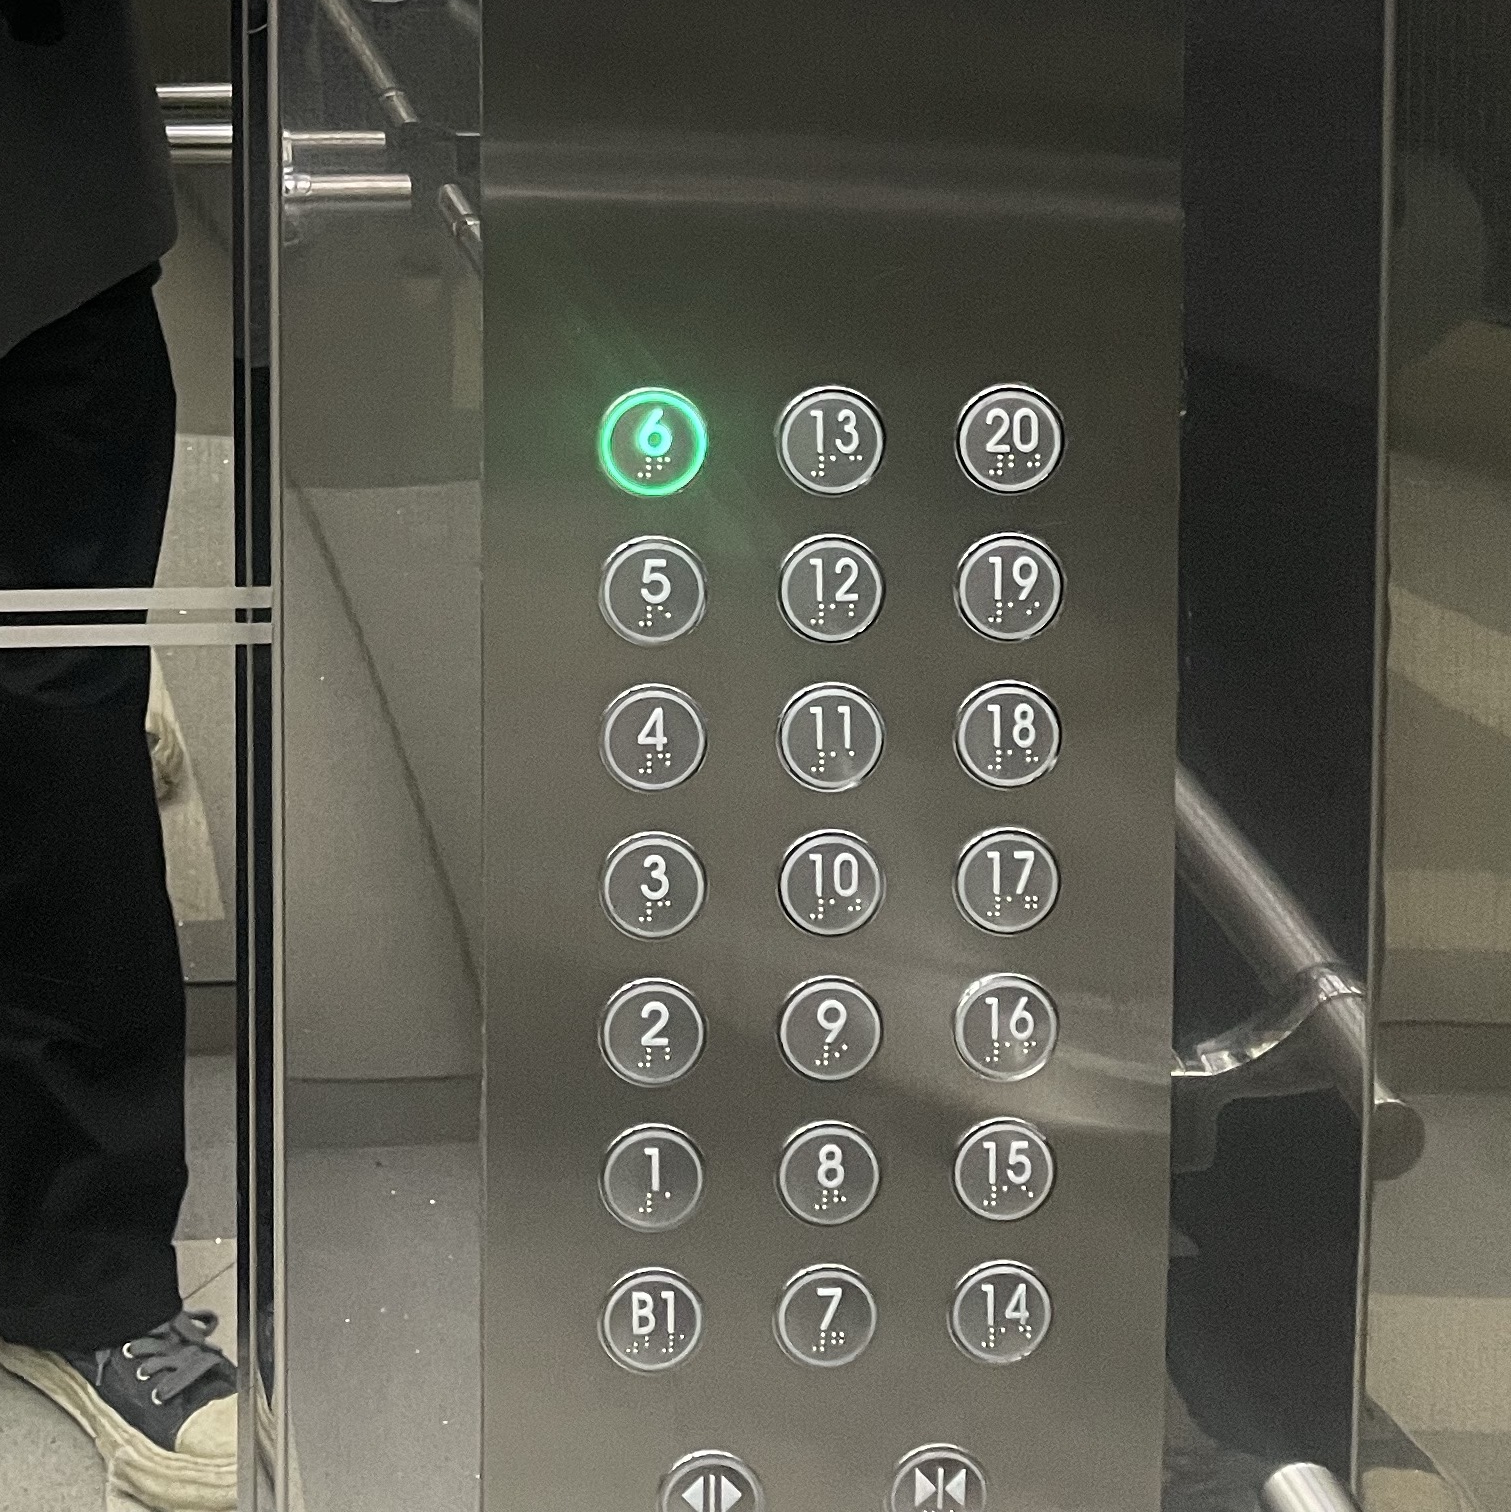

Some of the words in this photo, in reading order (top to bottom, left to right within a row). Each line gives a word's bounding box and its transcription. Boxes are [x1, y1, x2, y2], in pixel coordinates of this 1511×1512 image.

[638, 408, 673, 457] 6
[810, 409, 860, 454] 13
[986, 407, 1040, 453] 20
[640, 558, 672, 605] 5
[810, 557, 859, 602] 12
[988, 555, 1039, 601] 19
[637, 707, 668, 751] 4
[810, 706, 851, 751] 11
[987, 702, 1036, 749] 18
[640, 855, 670, 900] 3
[810, 852, 859, 897] 10
[987, 850, 1035, 896] 17
[641, 1001, 669, 1047] 2
[816, 999, 847, 1044] 9
[985, 997, 1034, 1041] 16
[643, 1147, 661, 1192] 1
[817, 1143, 845, 1189] 8
[982, 1141, 1032, 1185] 15
[631, 1290, 675, 1335] B1
[816, 1288, 842, 1331] 7
[981, 1283, 1030, 1326] 14
